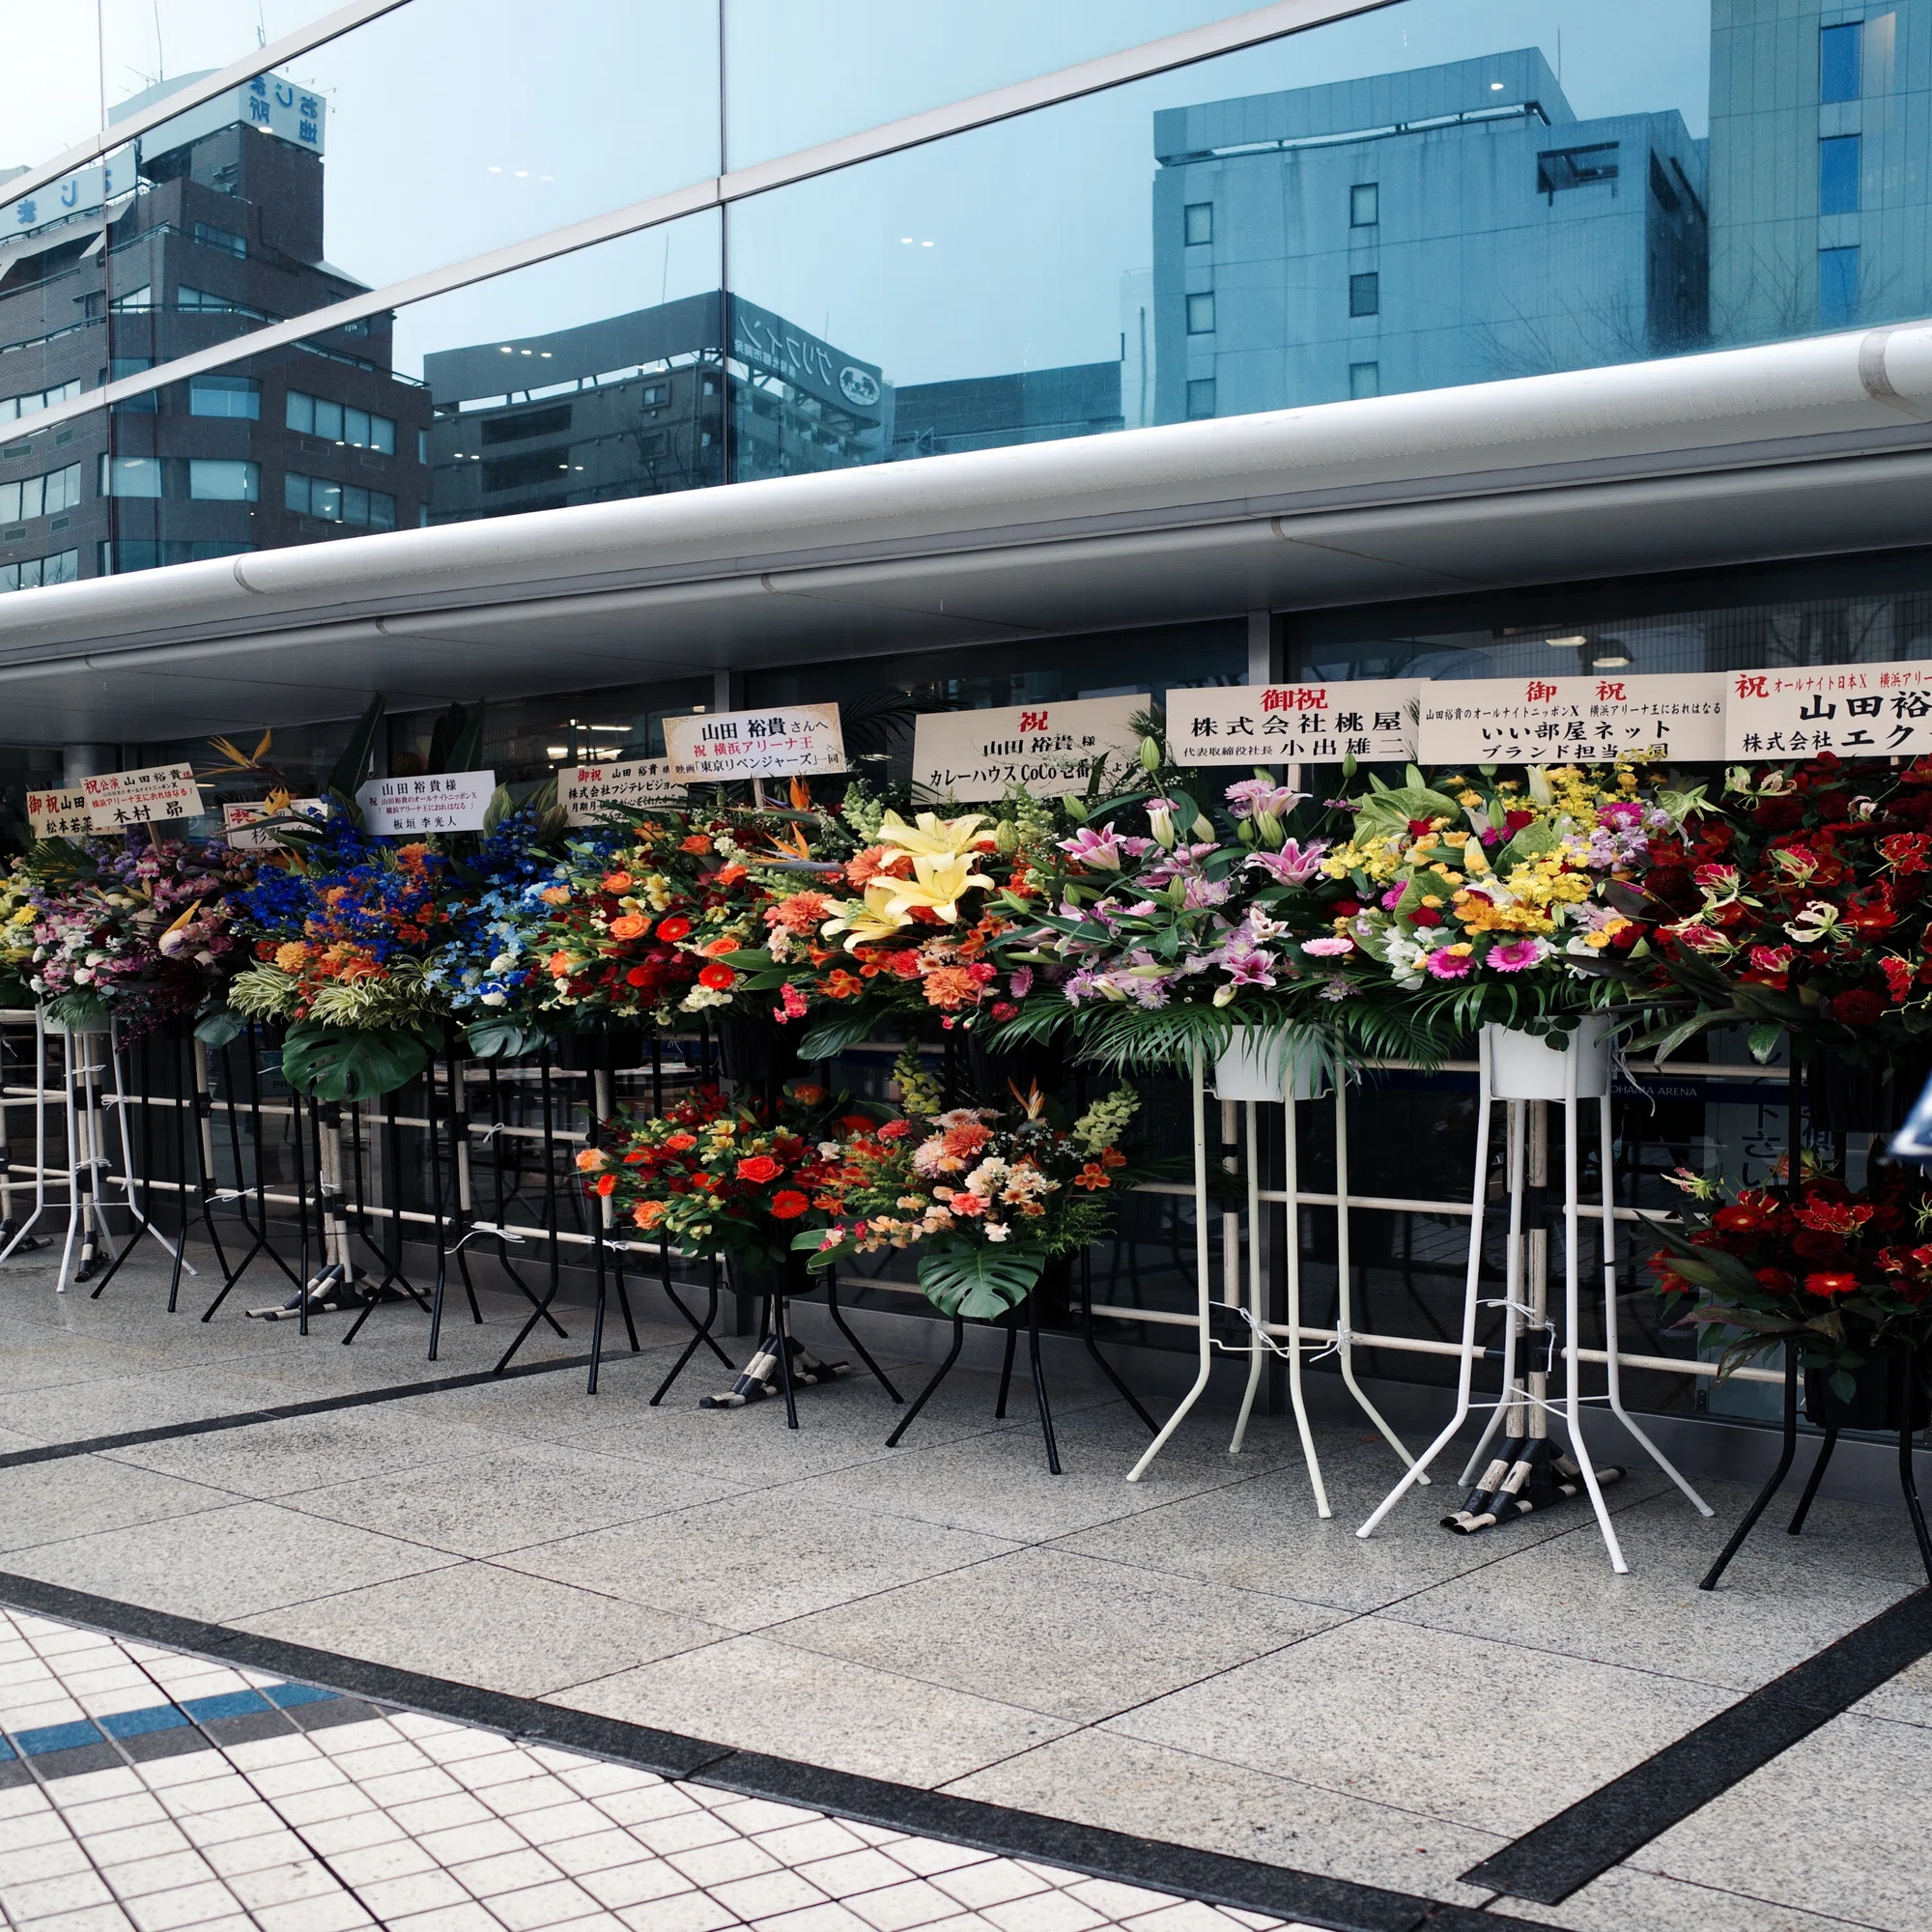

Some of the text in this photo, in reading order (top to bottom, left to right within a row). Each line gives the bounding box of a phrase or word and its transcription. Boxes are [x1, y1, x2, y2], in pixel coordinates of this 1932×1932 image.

[1734, 674, 1770, 699] 祝
[1260, 688, 1329, 712] 御祝
[1018, 710, 1049, 732] 祝
[1190, 711, 1403, 737] 株式会社桃屋
[1482, 720, 1671, 742] いい部屋ネット
[1657, 1087, 1698, 1097] ARENA
